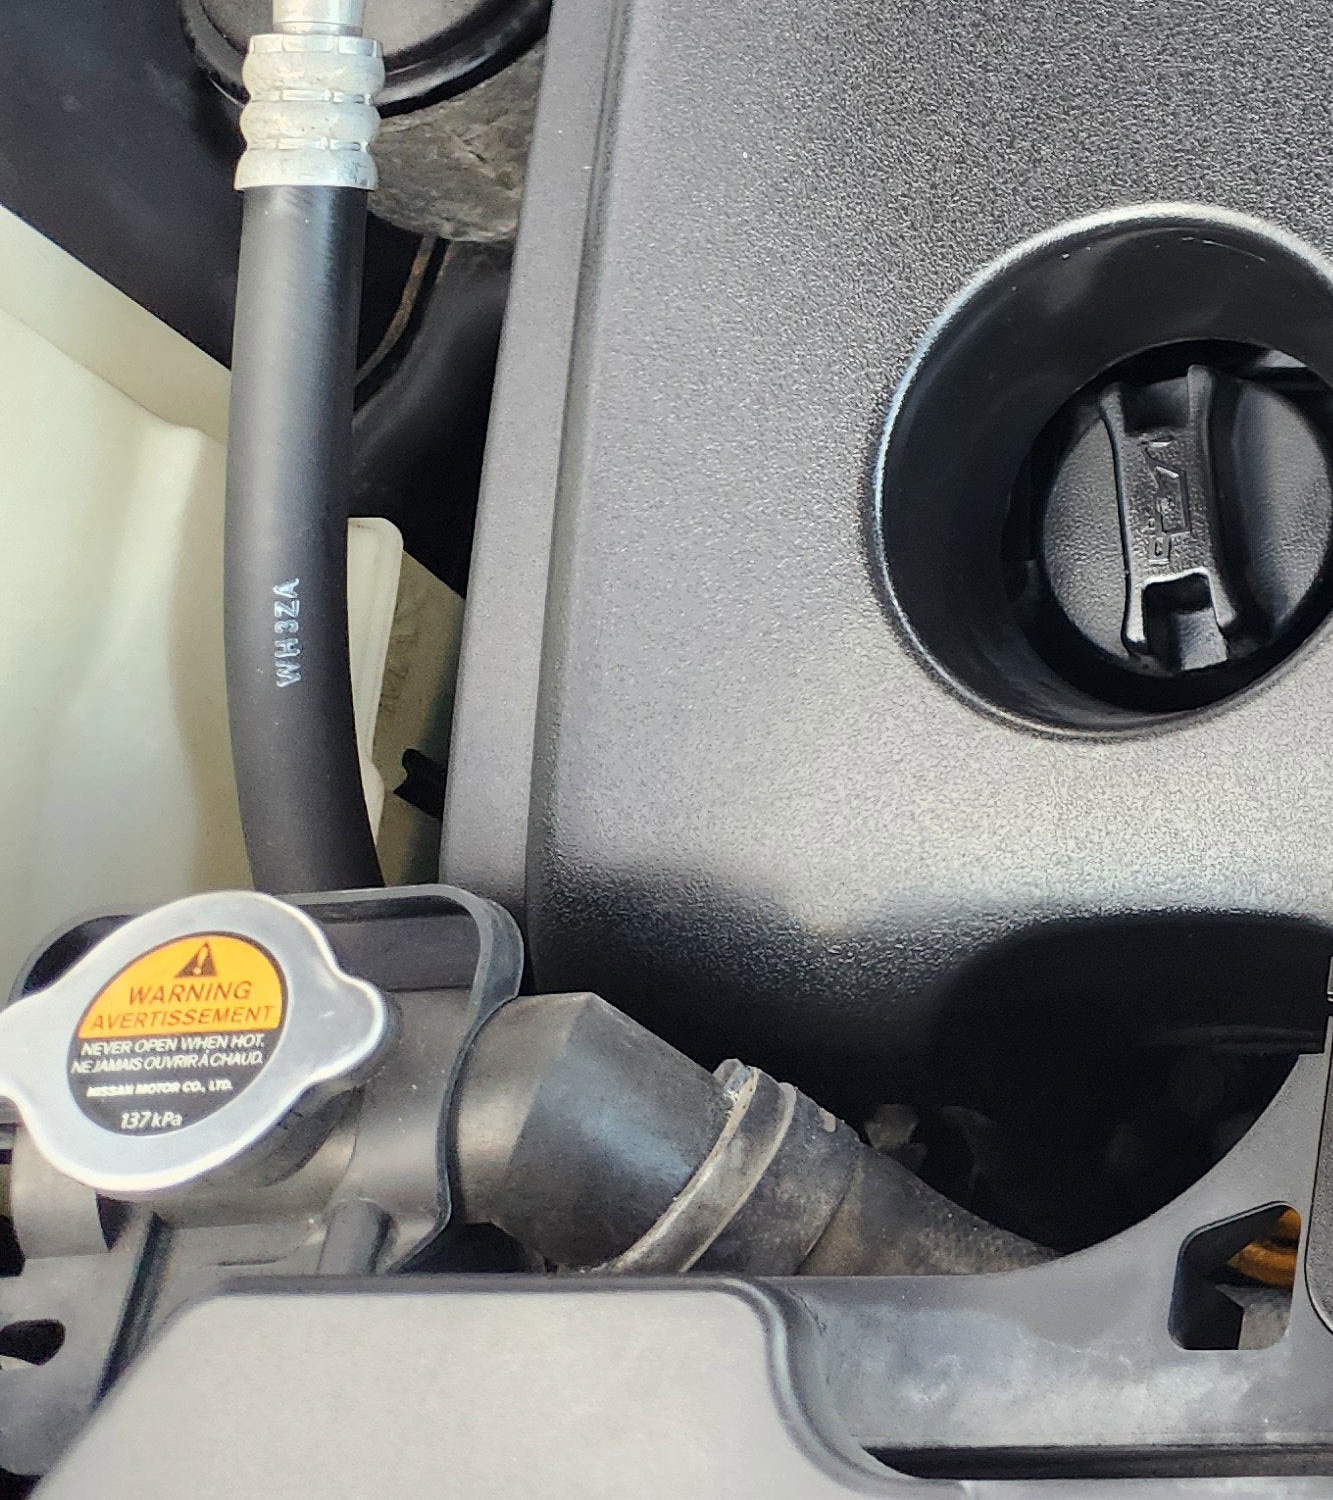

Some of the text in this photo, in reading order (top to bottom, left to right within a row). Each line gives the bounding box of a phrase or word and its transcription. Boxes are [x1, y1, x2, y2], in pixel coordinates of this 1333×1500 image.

[127, 980, 252, 1006] WARNING
[90, 1005, 276, 1032] AVERTISSEMENT
[80, 1033, 266, 1056] NEVER OPEN WHEN HOT.
[71, 1060, 95, 1074] NE
[93, 1057, 144, 1073] JAMAIS
[143, 1054, 199, 1071] OUVRIR
